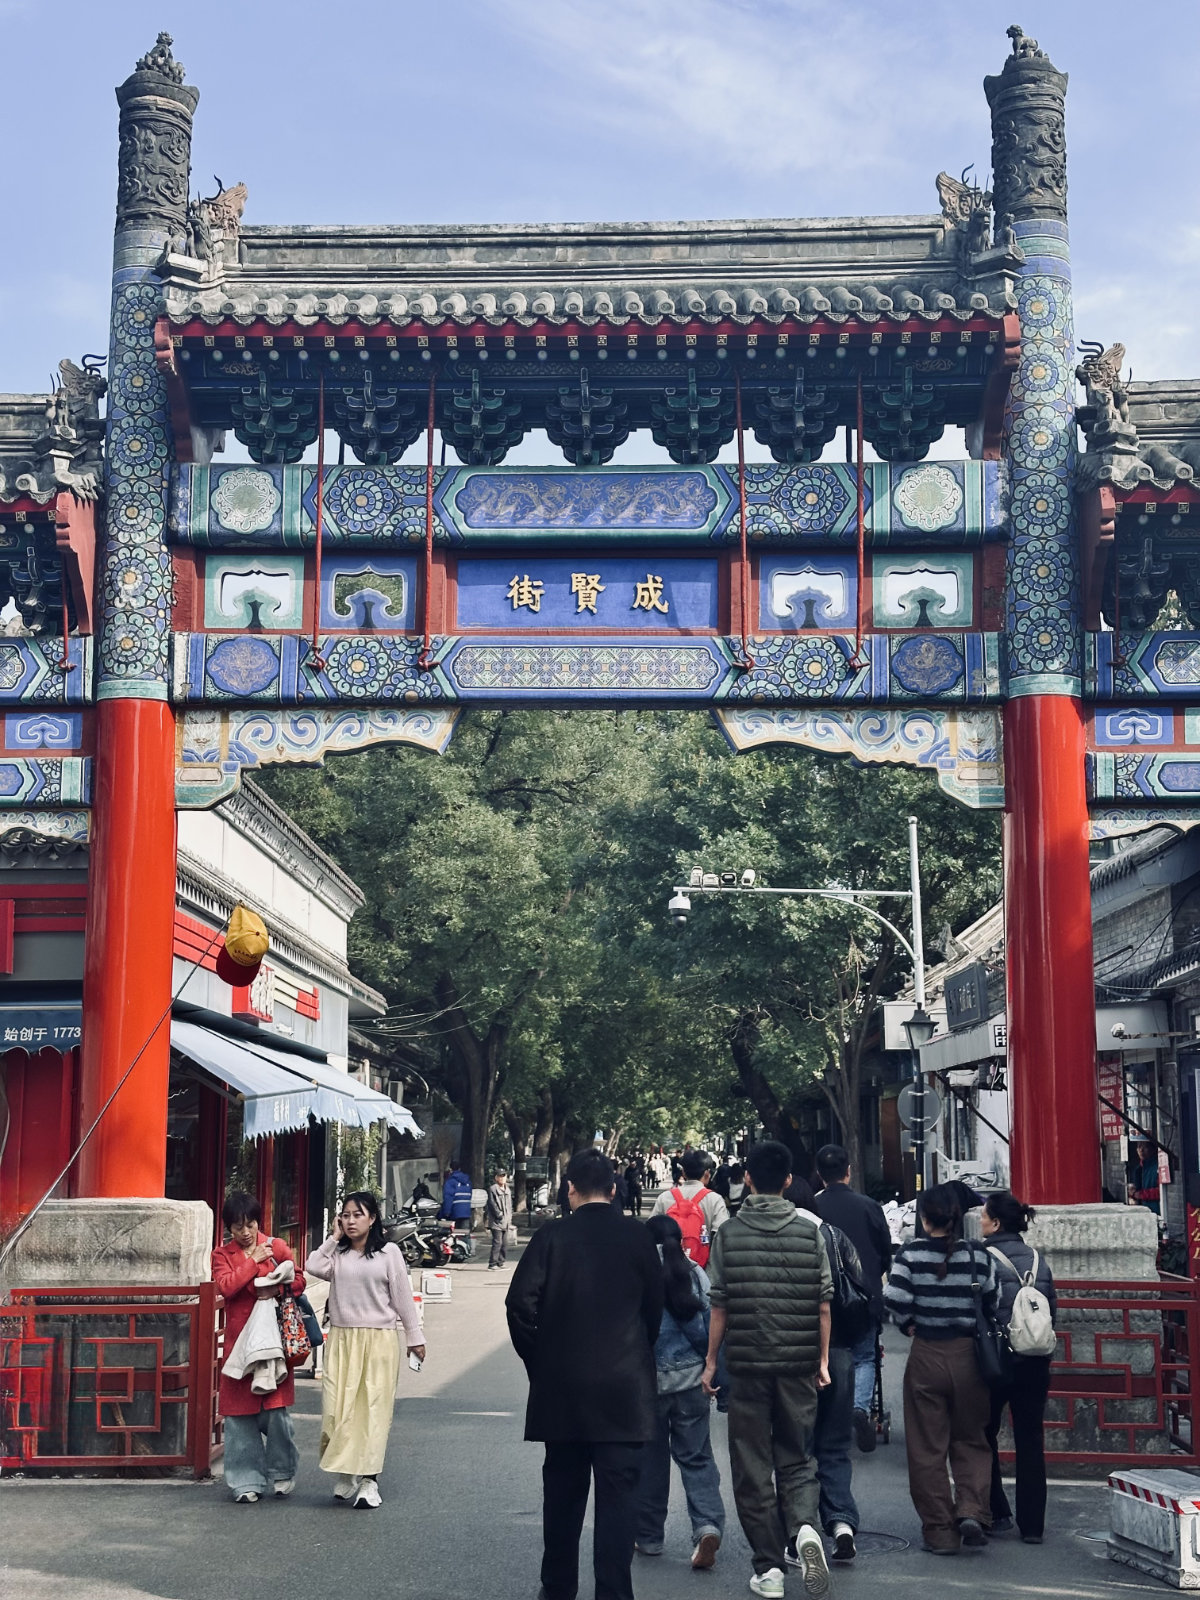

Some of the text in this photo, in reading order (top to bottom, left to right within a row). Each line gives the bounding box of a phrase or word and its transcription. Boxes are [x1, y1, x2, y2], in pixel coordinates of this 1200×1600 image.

[3, 1026, 82, 1041] 始创于 1773
